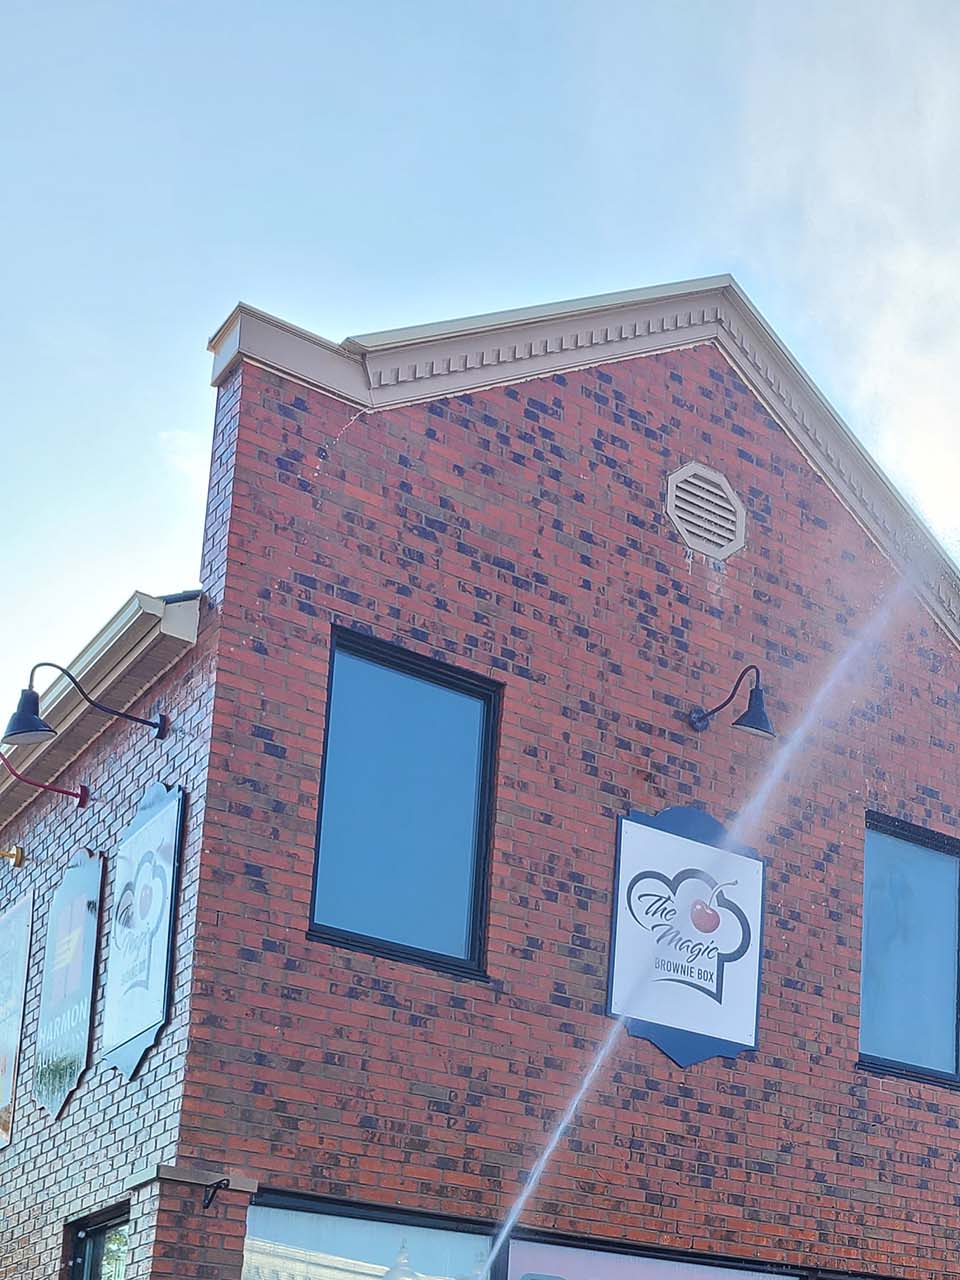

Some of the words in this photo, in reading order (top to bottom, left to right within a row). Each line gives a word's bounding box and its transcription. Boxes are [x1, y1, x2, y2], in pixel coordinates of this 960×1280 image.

[638, 893, 677, 921] The
[650, 922, 719, 965] Magic
[654, 956, 695, 979] BROWNIE
[697, 964, 714, 984] BOX
